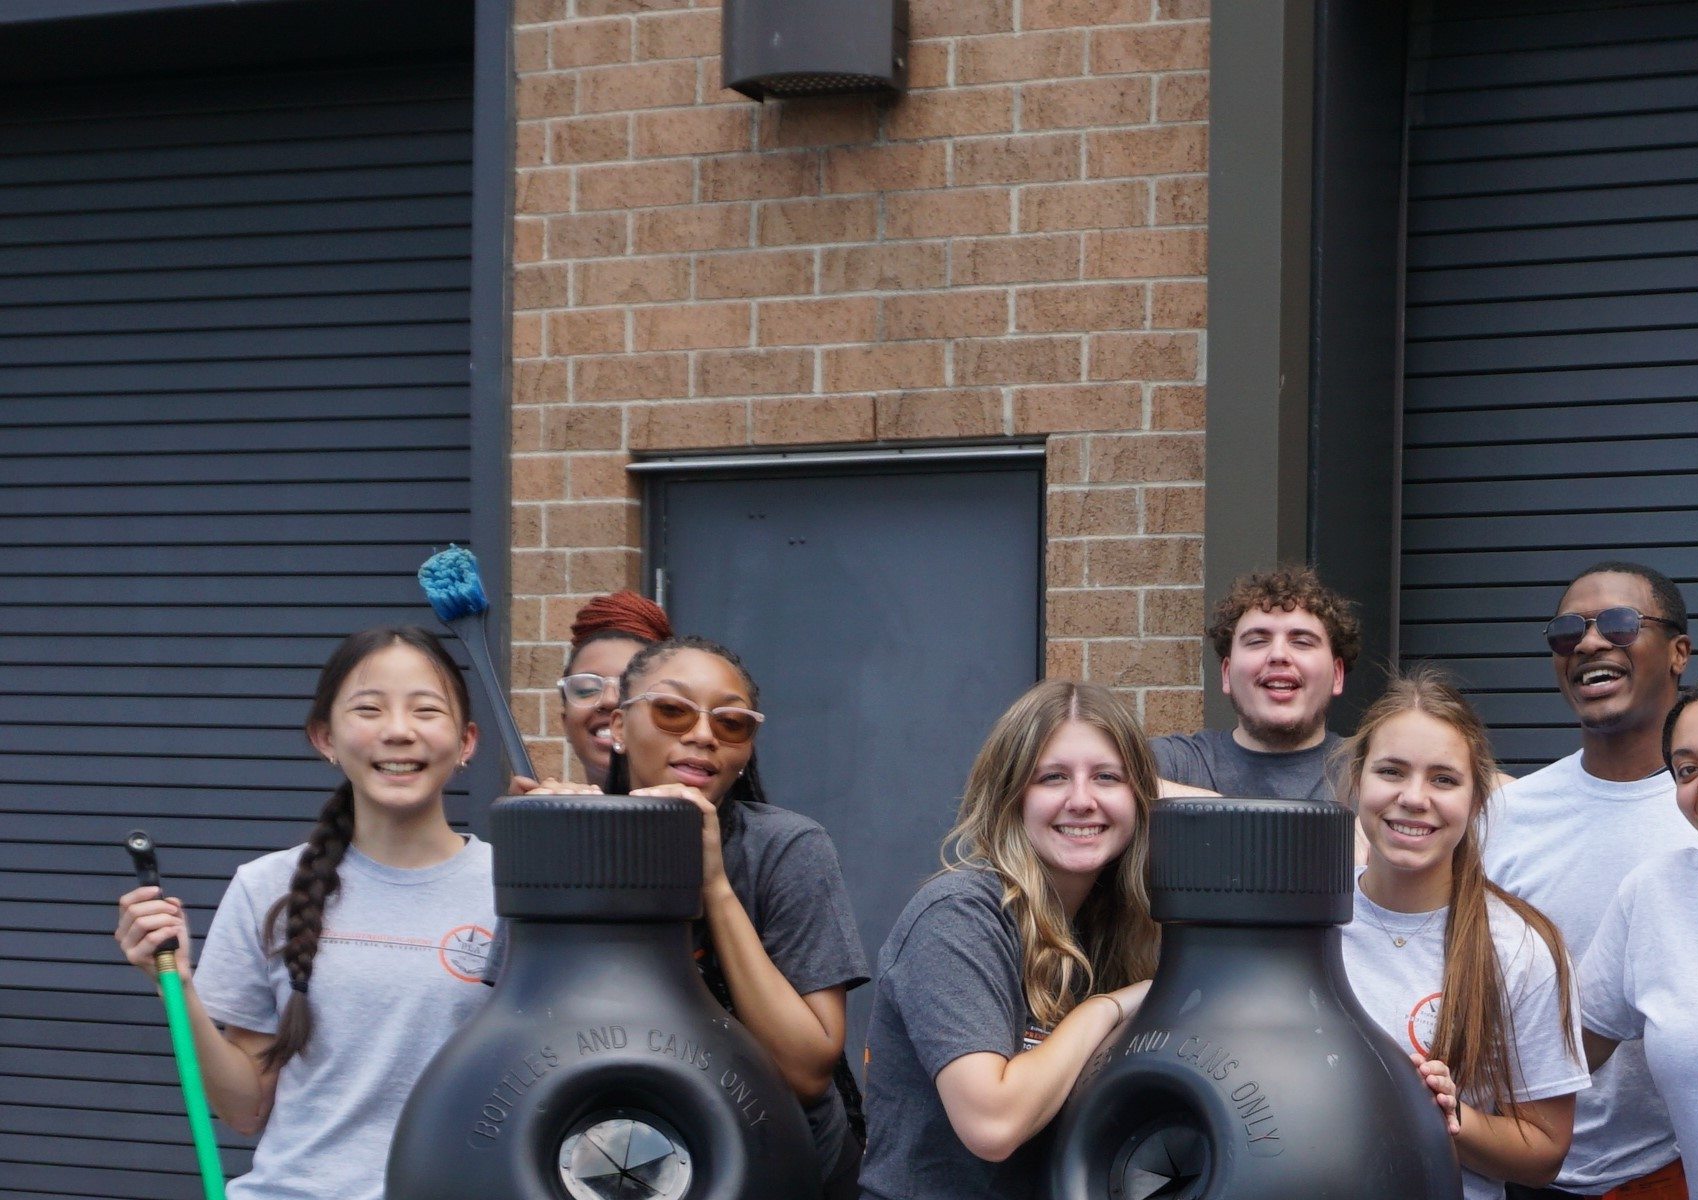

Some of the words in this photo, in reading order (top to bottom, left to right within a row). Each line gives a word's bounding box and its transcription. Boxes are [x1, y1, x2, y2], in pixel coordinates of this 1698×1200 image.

[473, 1046, 559, 1141] BOTTLES
[577, 1025, 628, 1054] AND
[647, 1028, 711, 1071] CANS
[719, 1070, 769, 1129] ONLY
[1125, 1030, 1171, 1056] AND
[1175, 1034, 1240, 1082] CANS
[1230, 1081, 1281, 1145] ONLY
